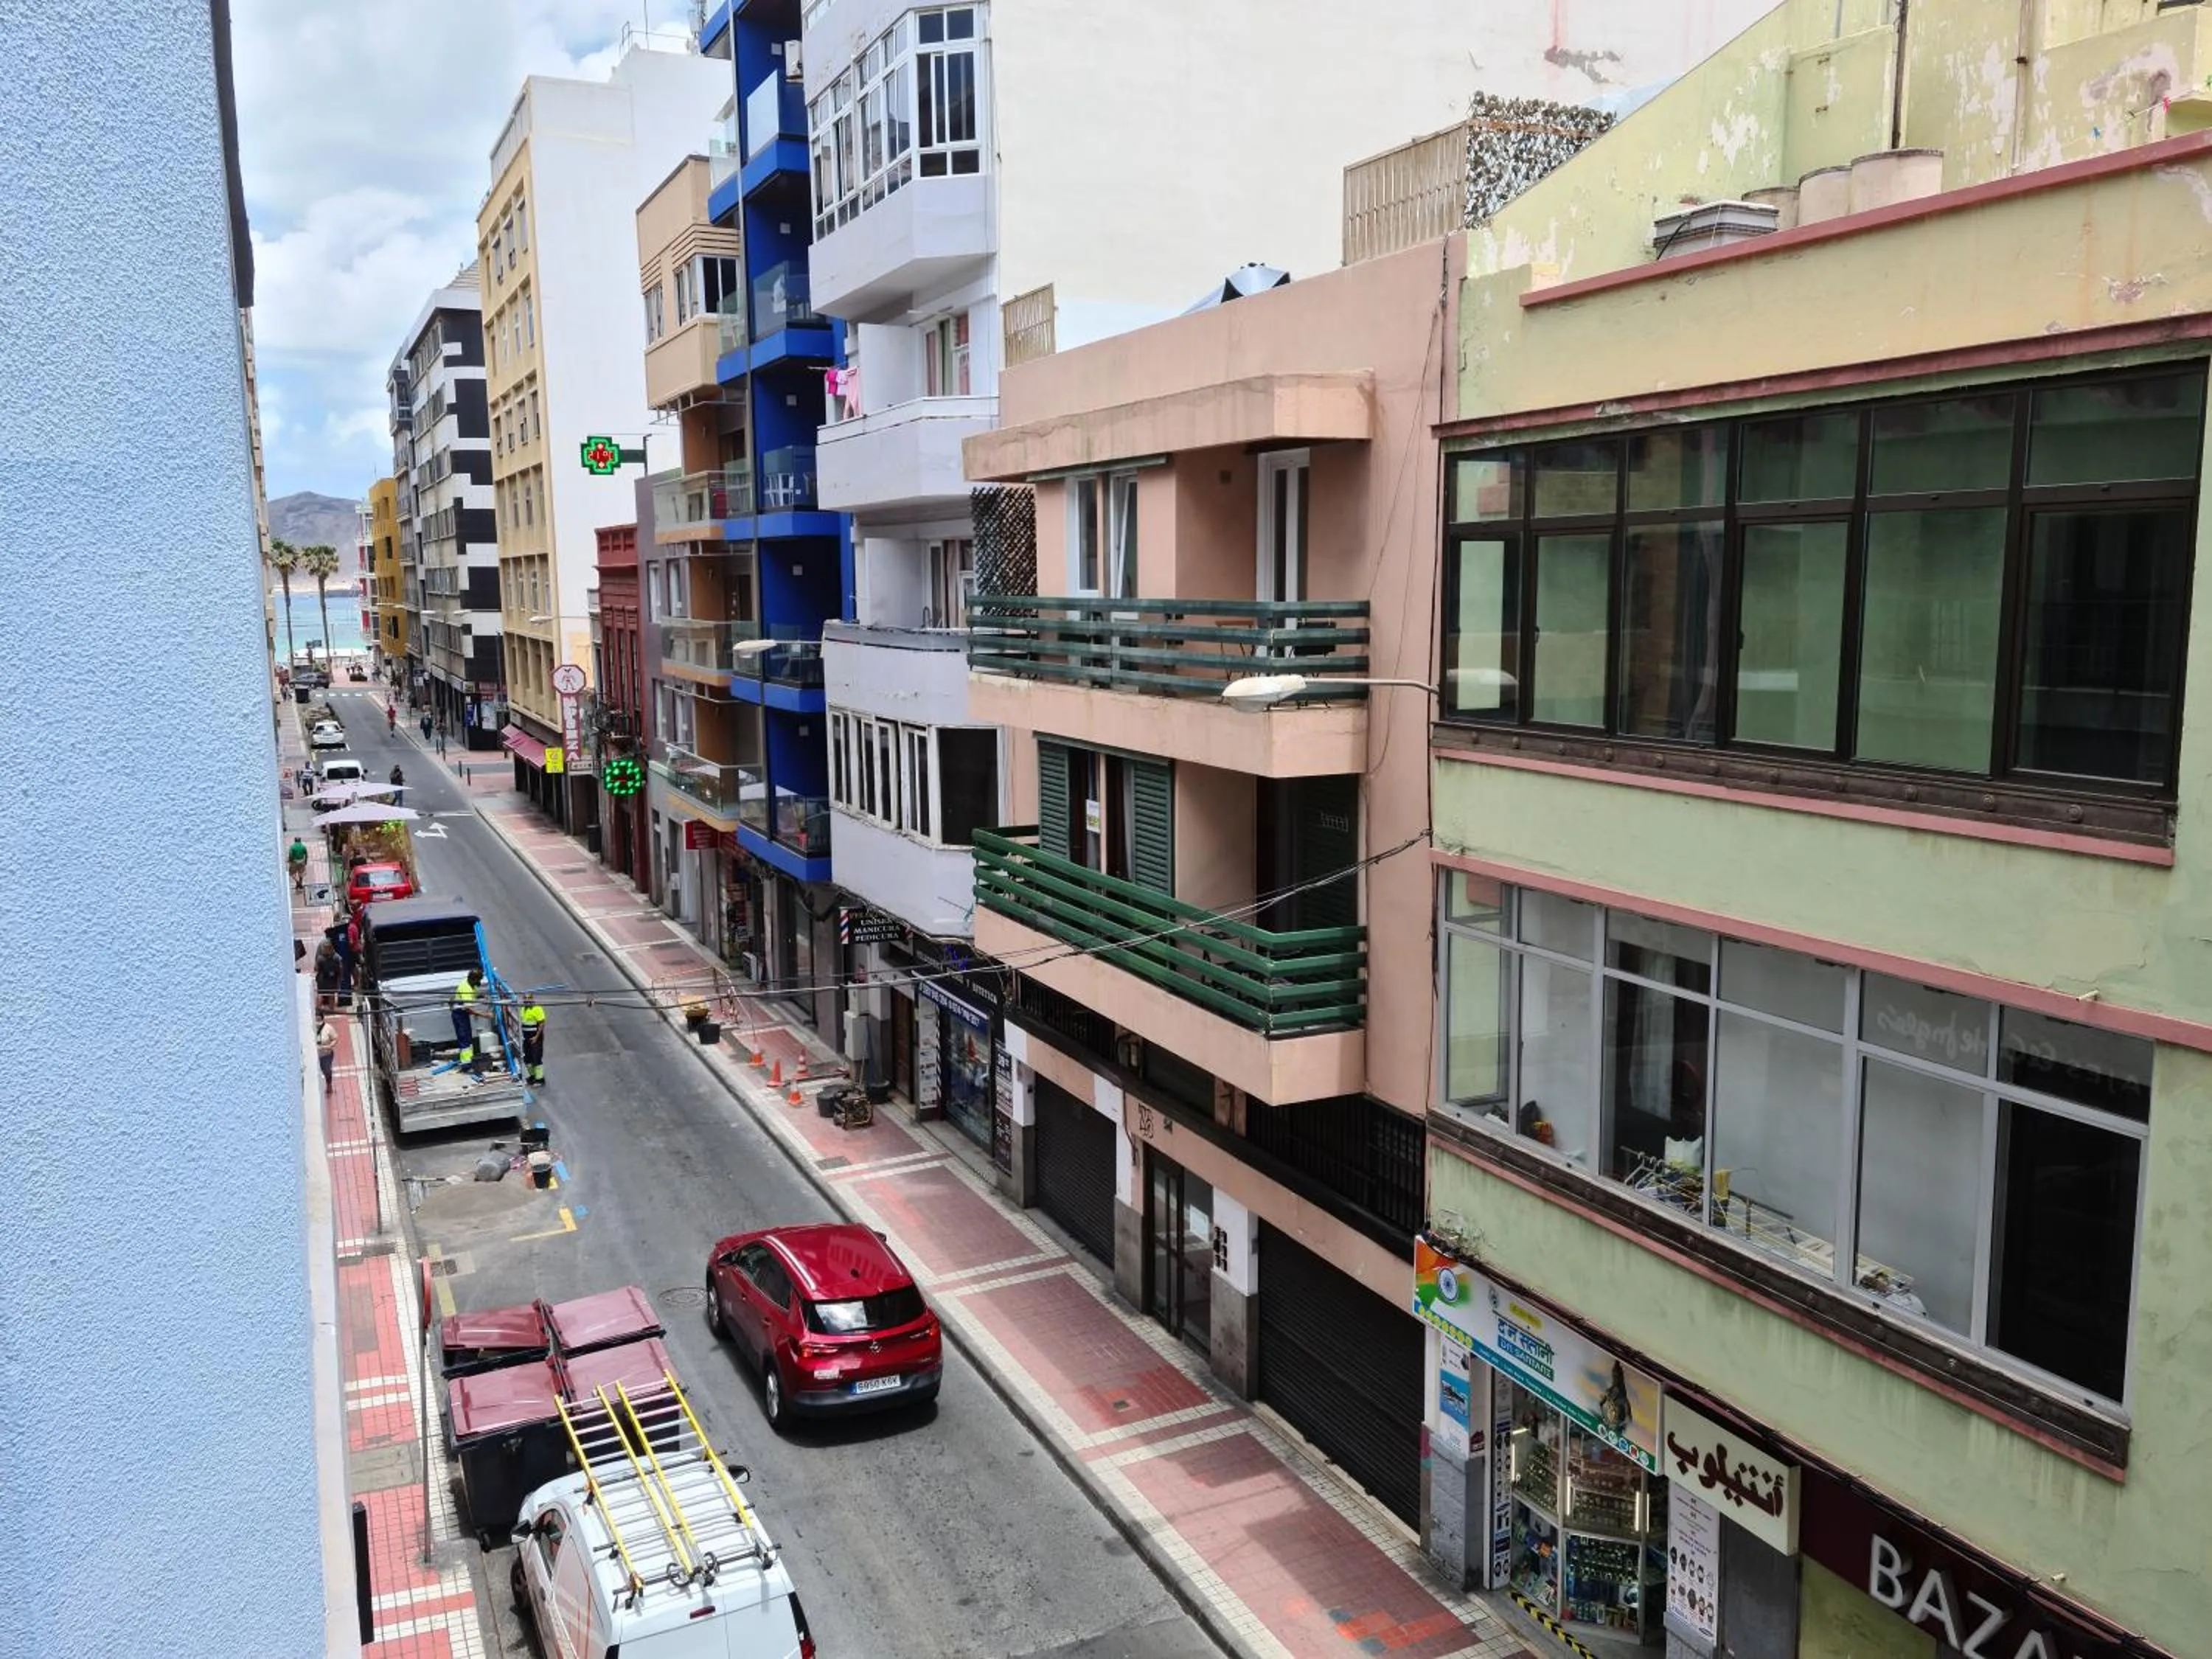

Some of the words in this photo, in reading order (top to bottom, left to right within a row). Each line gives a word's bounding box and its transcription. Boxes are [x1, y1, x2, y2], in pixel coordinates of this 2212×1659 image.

[853, 925, 900, 934] MANICURA
[855, 933, 899, 942] PEDICURA
[1869, 1533, 2081, 1659] BAZ
